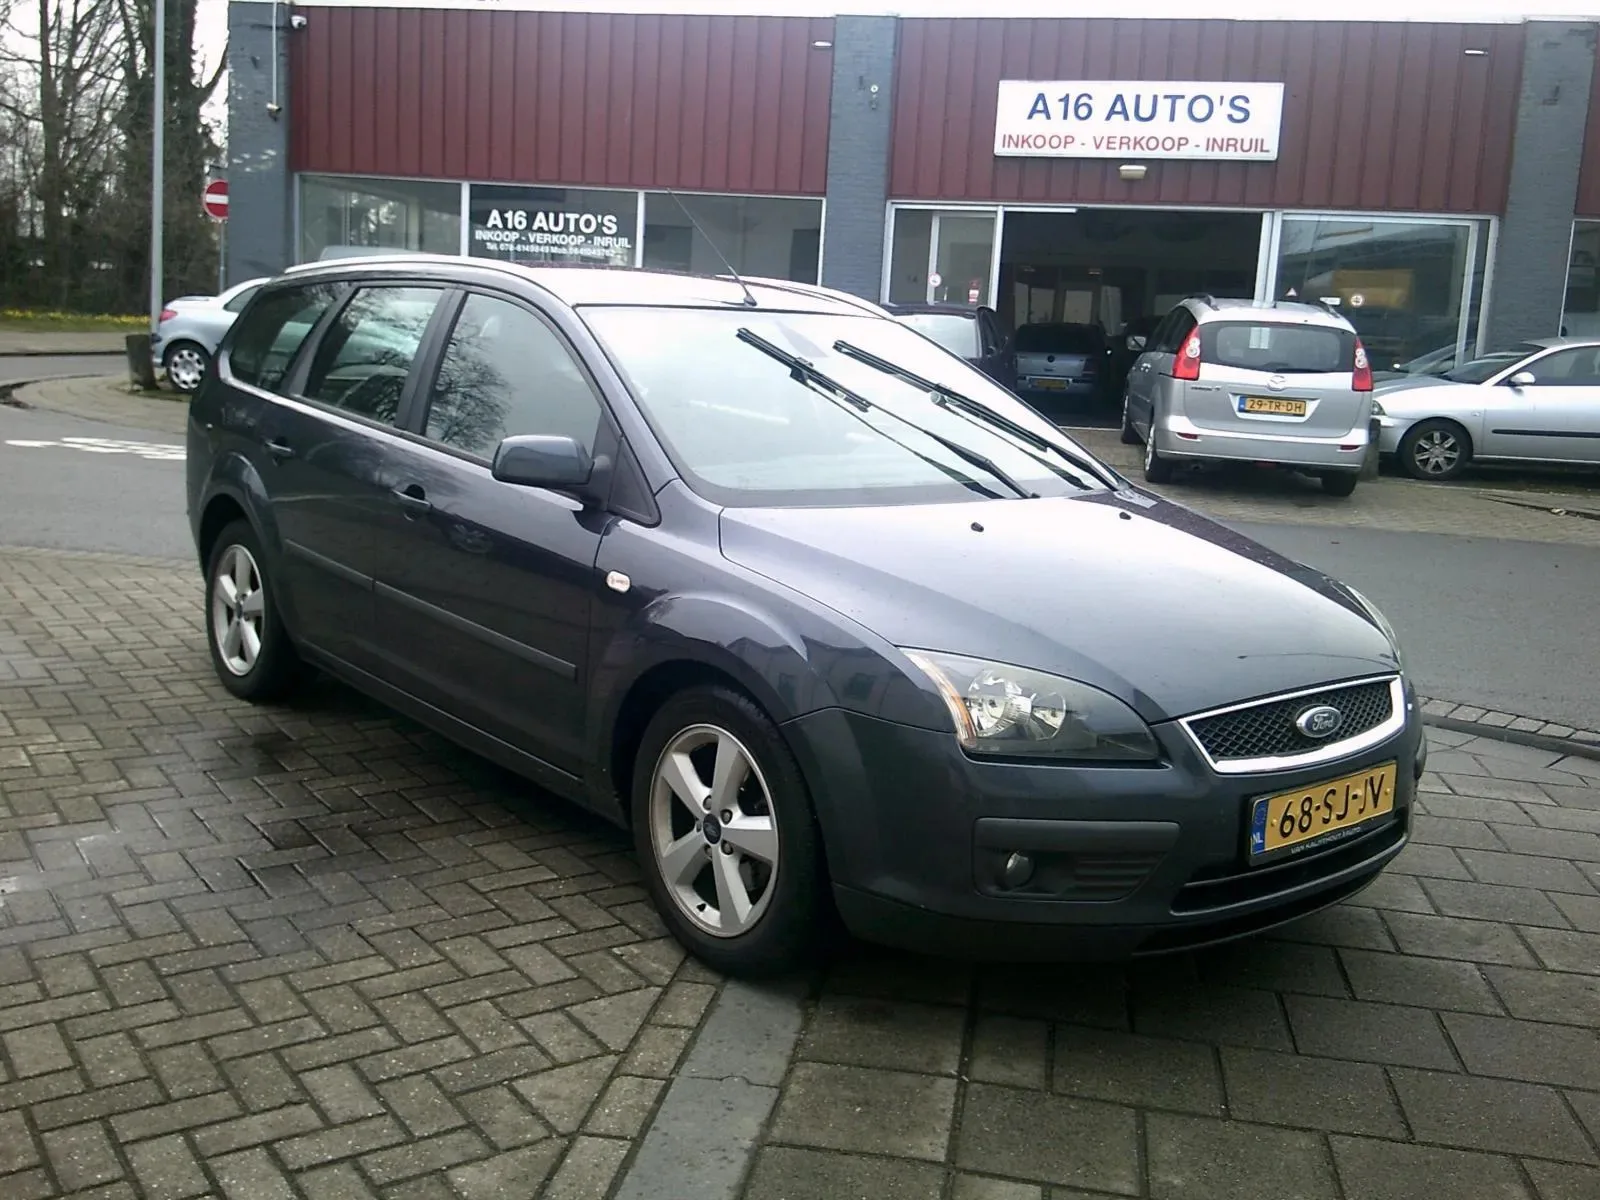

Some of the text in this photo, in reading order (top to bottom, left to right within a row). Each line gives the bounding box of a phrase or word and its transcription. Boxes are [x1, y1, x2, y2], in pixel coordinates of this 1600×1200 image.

[1027, 92, 1251, 124] A16 AUTO'S
[1002, 134, 1075, 150] INKOOP
[1093, 135, 1189, 151] VERKOOP
[1205, 137, 1270, 153] INRUIL
[486, 209, 618, 235] A16 AUTO'S
[475, 230, 520, 243] INKOOP
[528, 233, 586, 246] VERKOOP
[593, 236, 632, 249] INRUIL
[1249, 399, 1303, 412] 29-TR-DH
[1312, 713, 1335, 731] Ford
[1279, 773, 1385, 838] 68-SJ-JV
[1252, 832, 1264, 845] NL
